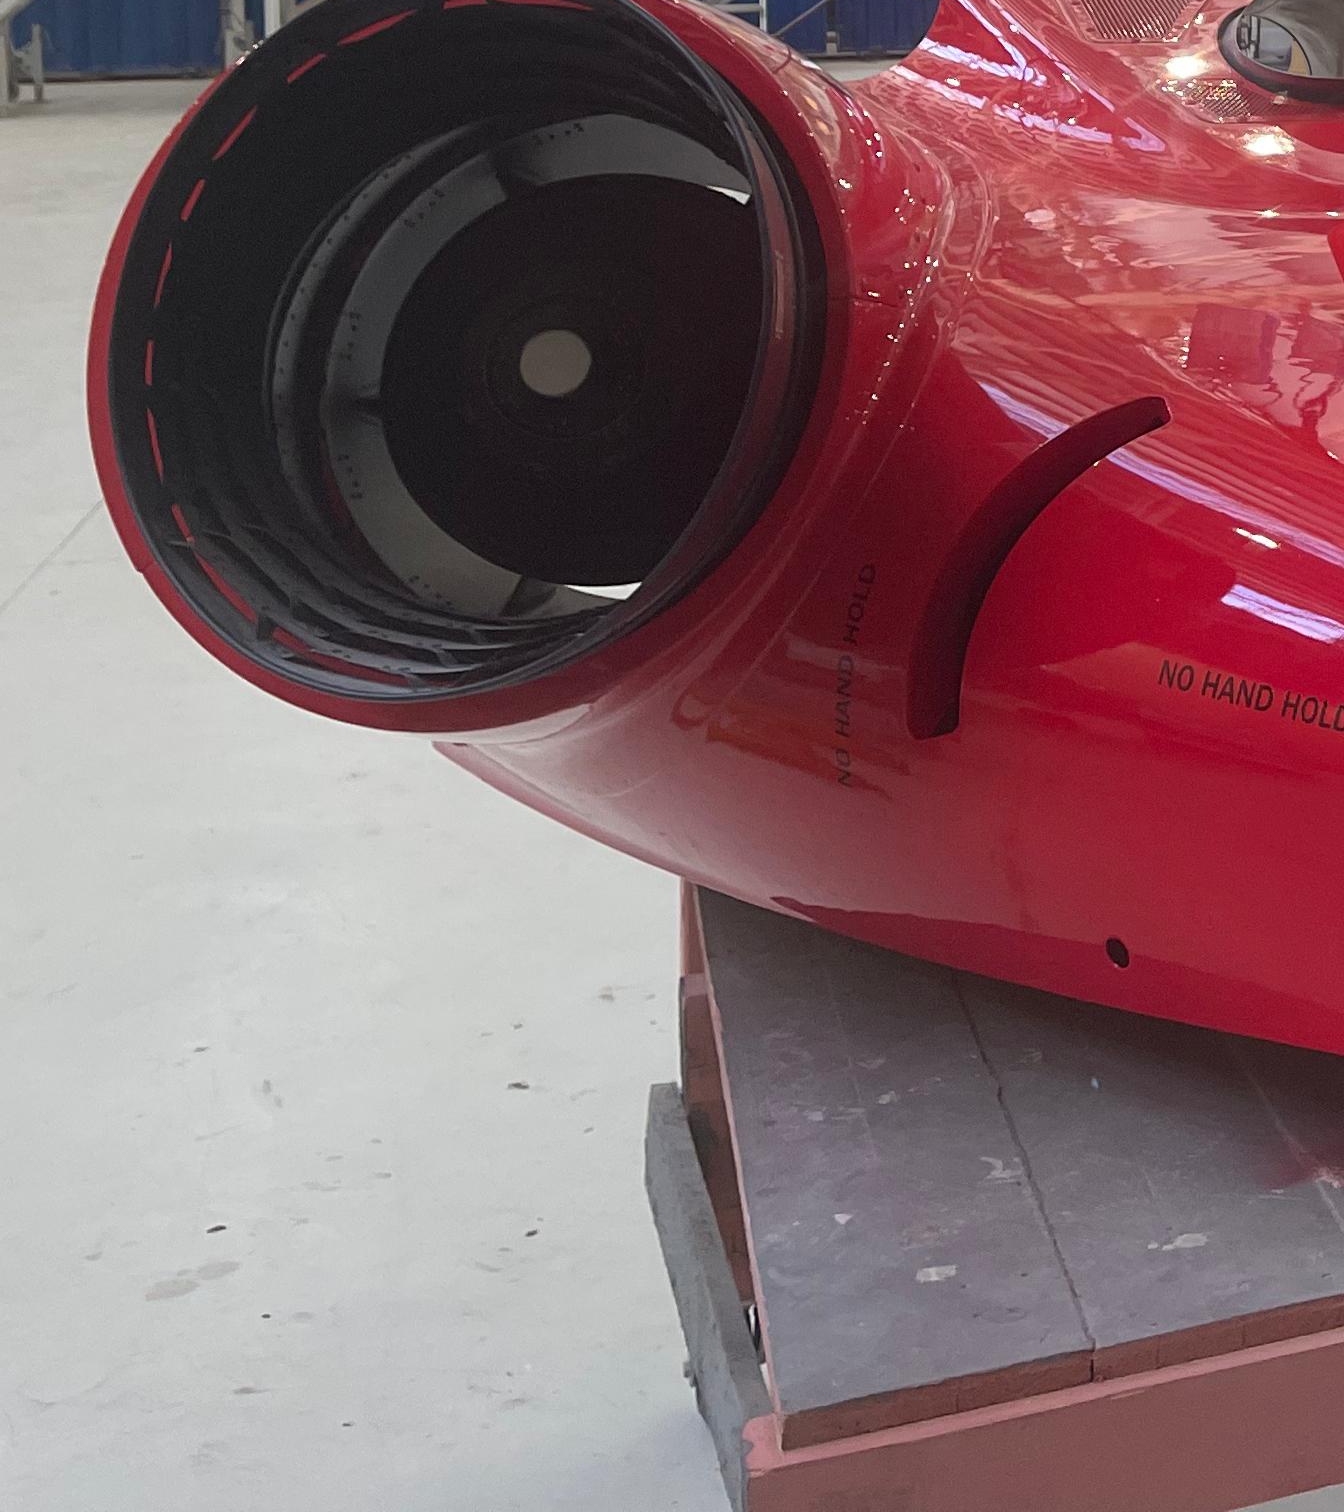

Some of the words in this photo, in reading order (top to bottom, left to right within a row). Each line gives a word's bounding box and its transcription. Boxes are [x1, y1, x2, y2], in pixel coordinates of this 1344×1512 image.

[842, 562, 877, 645] HOLD
[834, 654, 855, 738] HAND
[1157, 658, 1195, 693] NO
[1200, 669, 1274, 712] HAND
[835, 747, 852, 787] NO
